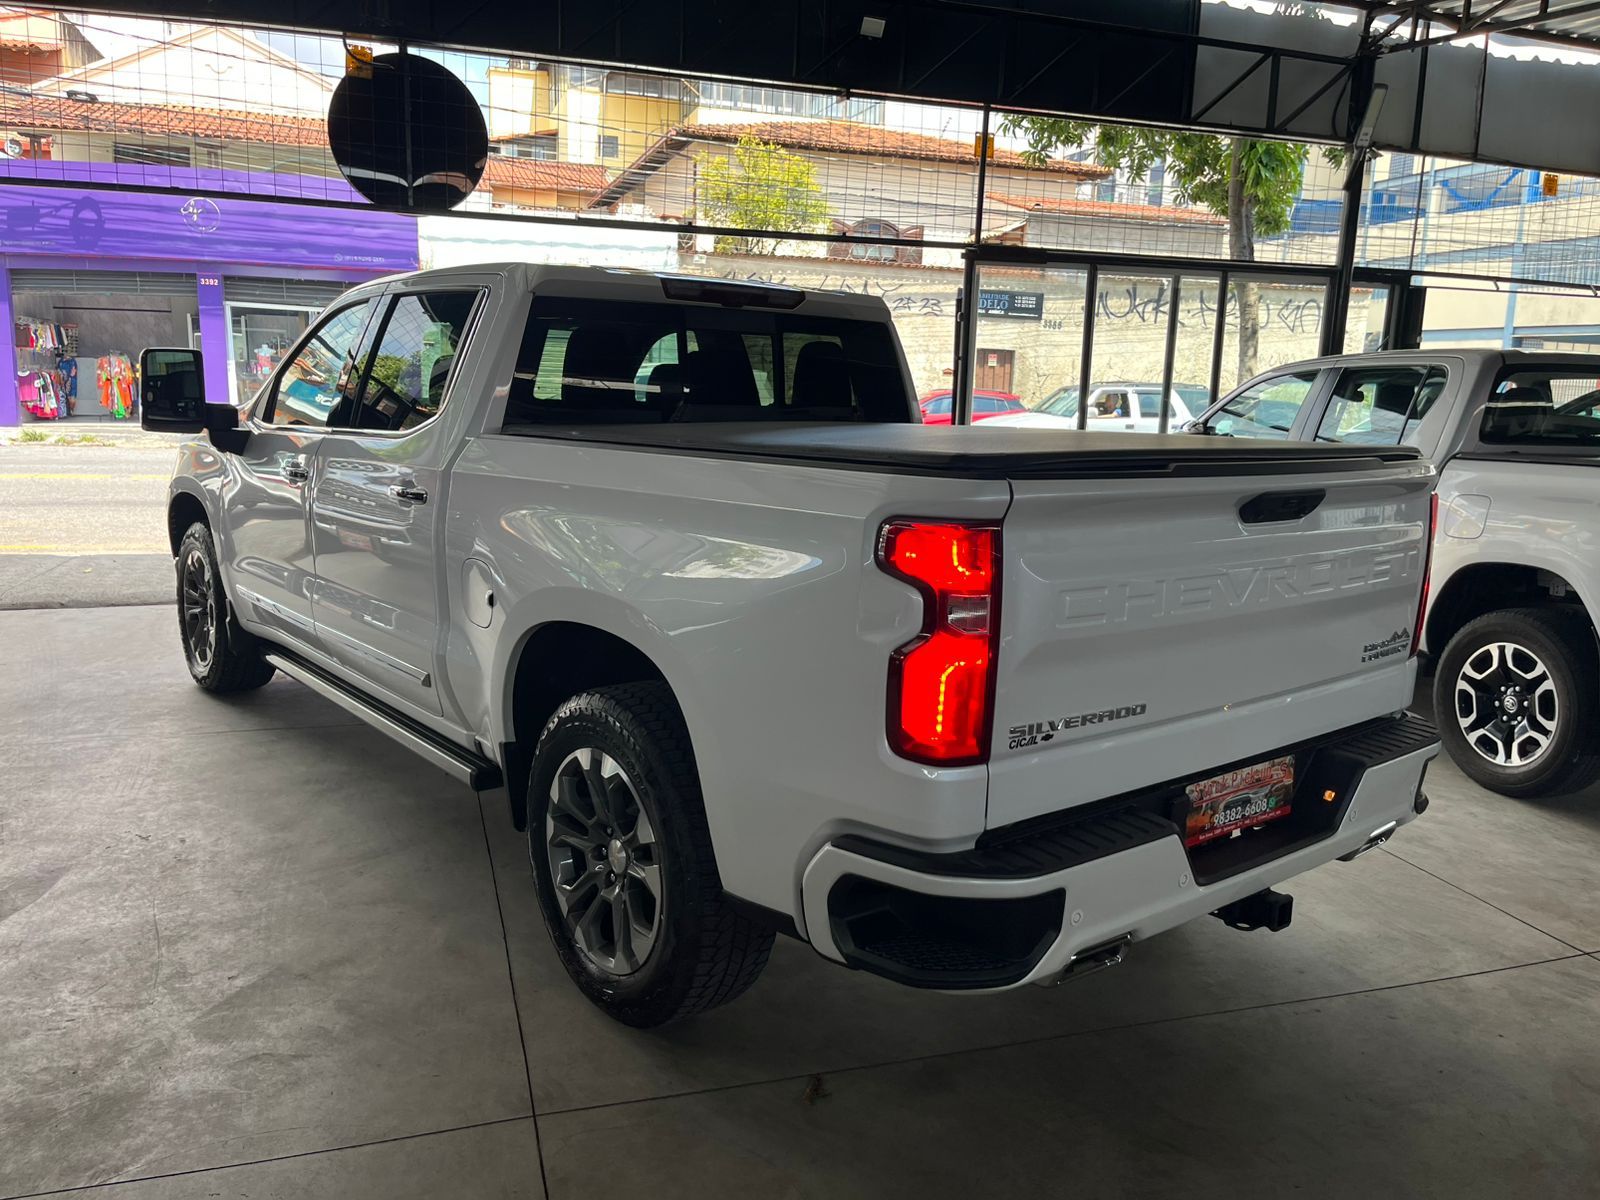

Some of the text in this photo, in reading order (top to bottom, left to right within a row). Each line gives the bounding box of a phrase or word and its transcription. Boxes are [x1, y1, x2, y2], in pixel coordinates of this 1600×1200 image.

[200, 278, 218, 286] 3392
[979, 298, 1009, 310] DELO
[1055, 548, 1418, 629] CHEVROLET
[1008, 703, 1147, 740] SILVERADO
[1008, 735, 1039, 750] CICAL
[1213, 798, 1268, 828] 98382-6608
